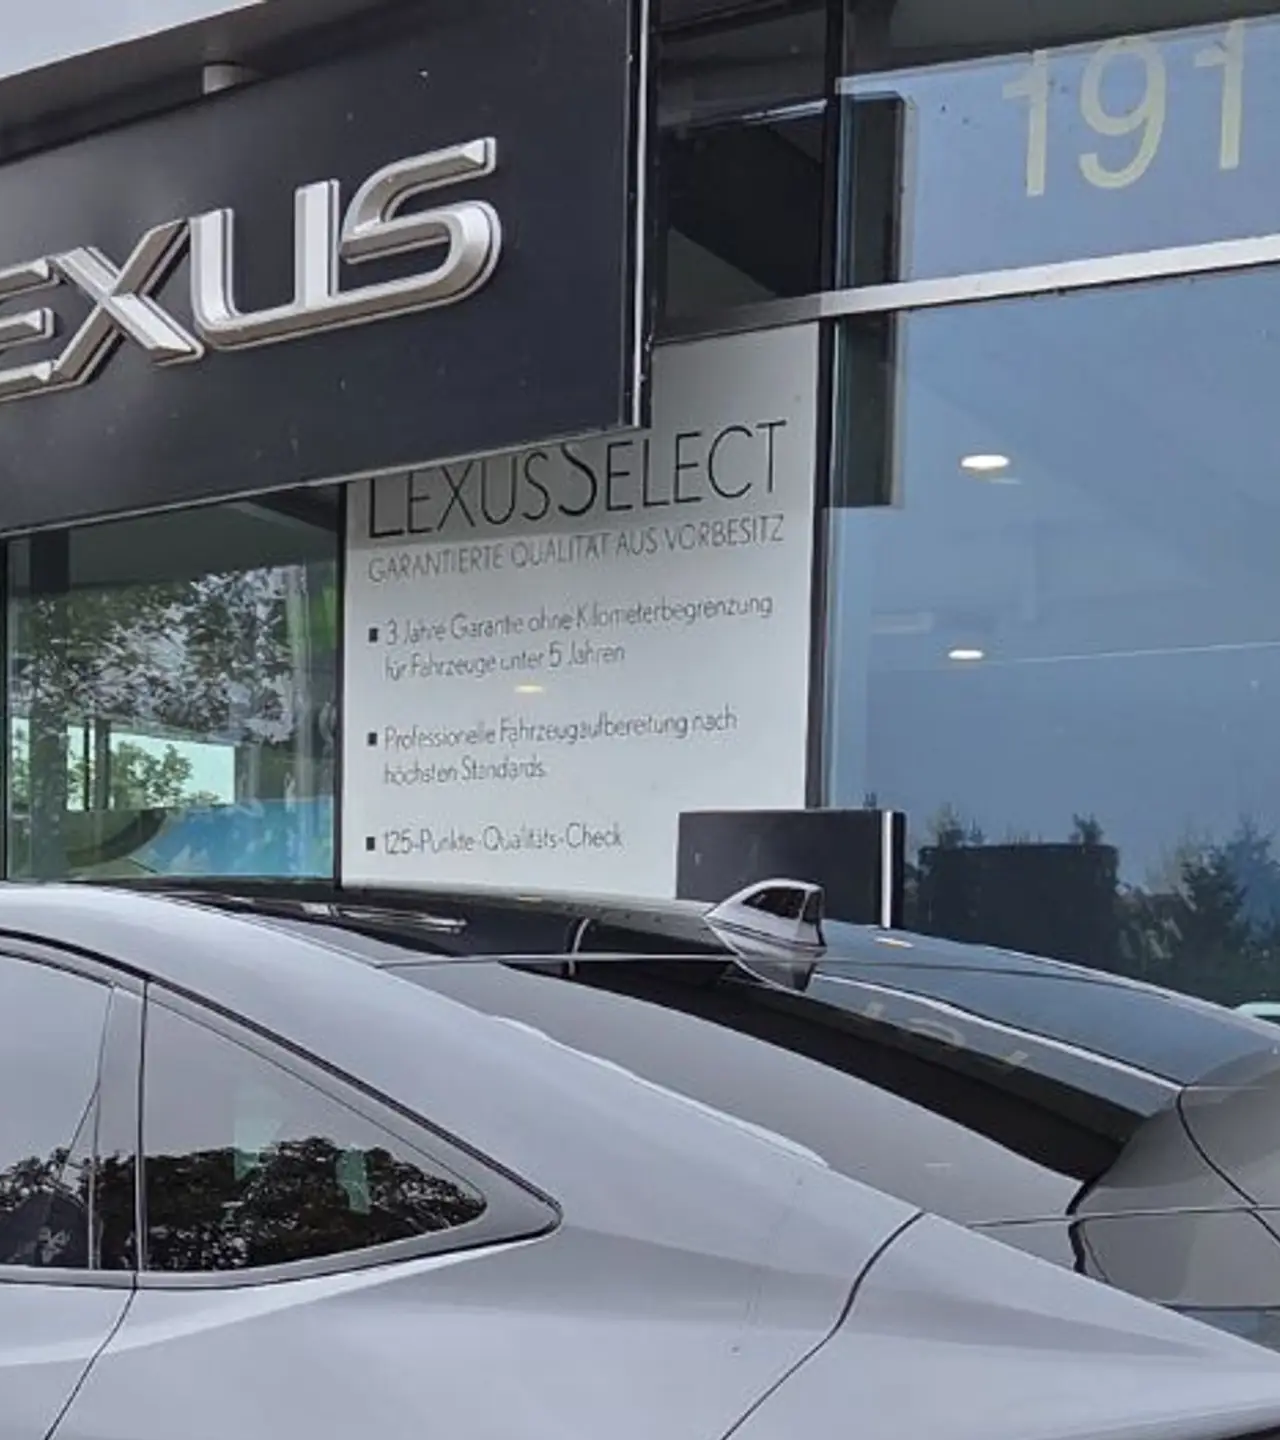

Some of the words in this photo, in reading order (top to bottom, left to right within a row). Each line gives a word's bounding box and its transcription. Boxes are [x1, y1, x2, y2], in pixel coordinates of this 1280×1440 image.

[1003, 19, 1245, 196] 191
[369, 544, 504, 582] GARANTIERTE
[617, 526, 658, 557] AUS
[664, 514, 785, 551] VORBESITZ
[385, 617, 398, 646] 3
[403, 616, 447, 644] Jahre
[528, 604, 573, 633] ohne
[411, 650, 497, 679] Fahrzeuge
[501, 649, 545, 671] unter
[549, 640, 562, 668] 5
[568, 638, 626, 665] Jahren
[692, 702, 738, 731] nach
